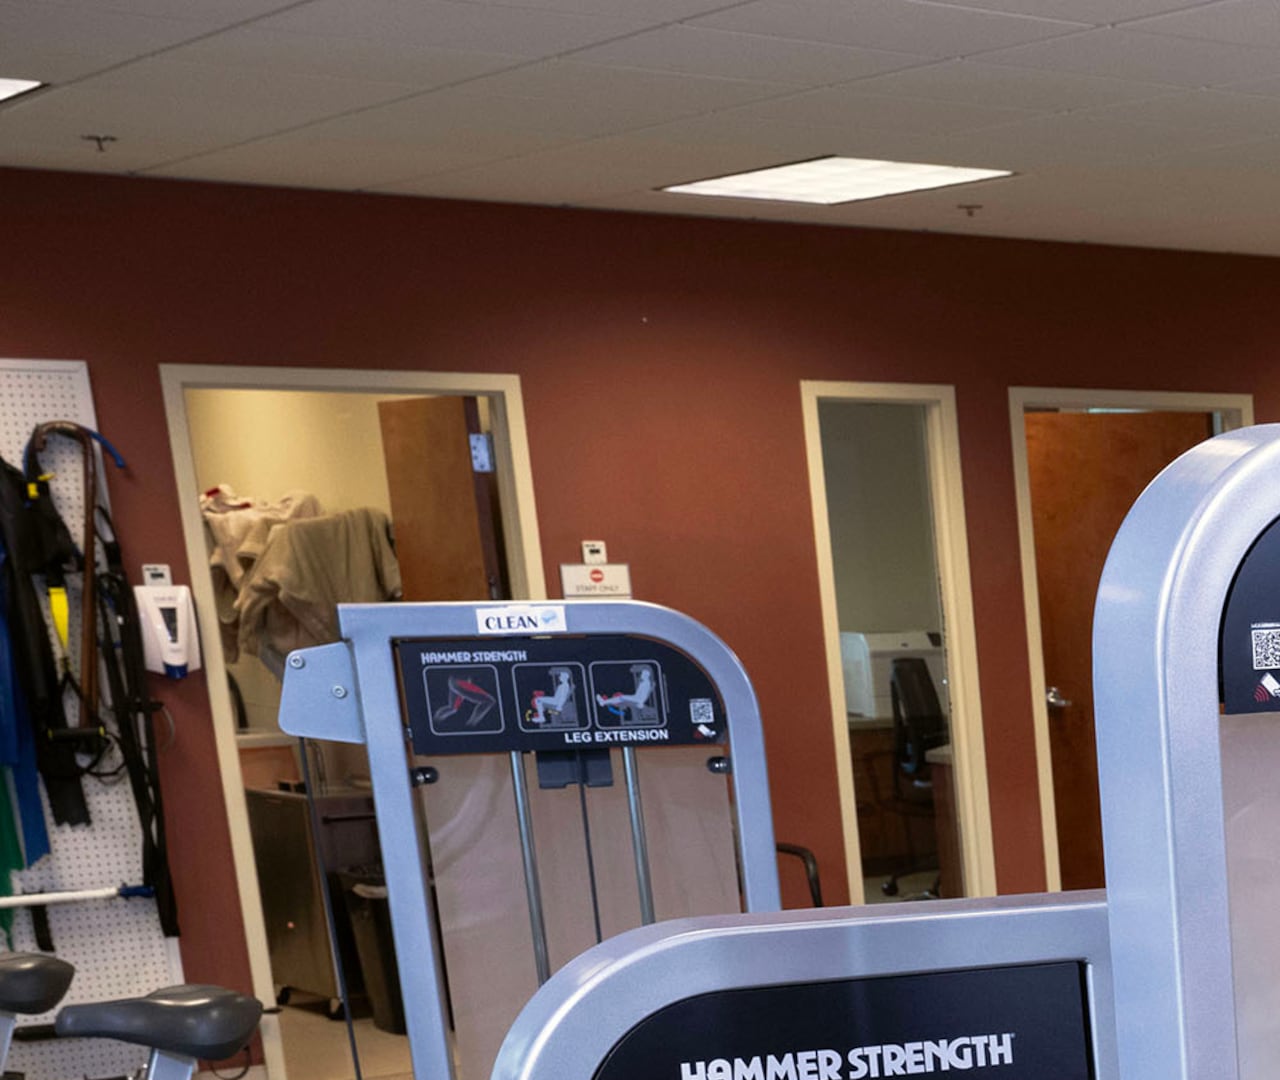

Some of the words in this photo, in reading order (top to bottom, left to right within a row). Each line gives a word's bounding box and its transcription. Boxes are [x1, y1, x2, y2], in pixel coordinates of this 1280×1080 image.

[485, 615, 538, 630] CLEAN
[420, 651, 472, 665] HAMMER
[472, 650, 527, 662] STRENGTH
[564, 732, 592, 743] LEG
[594, 729, 669, 742] EXTENSION
[847, 1032, 1014, 1080] STRENGTH
